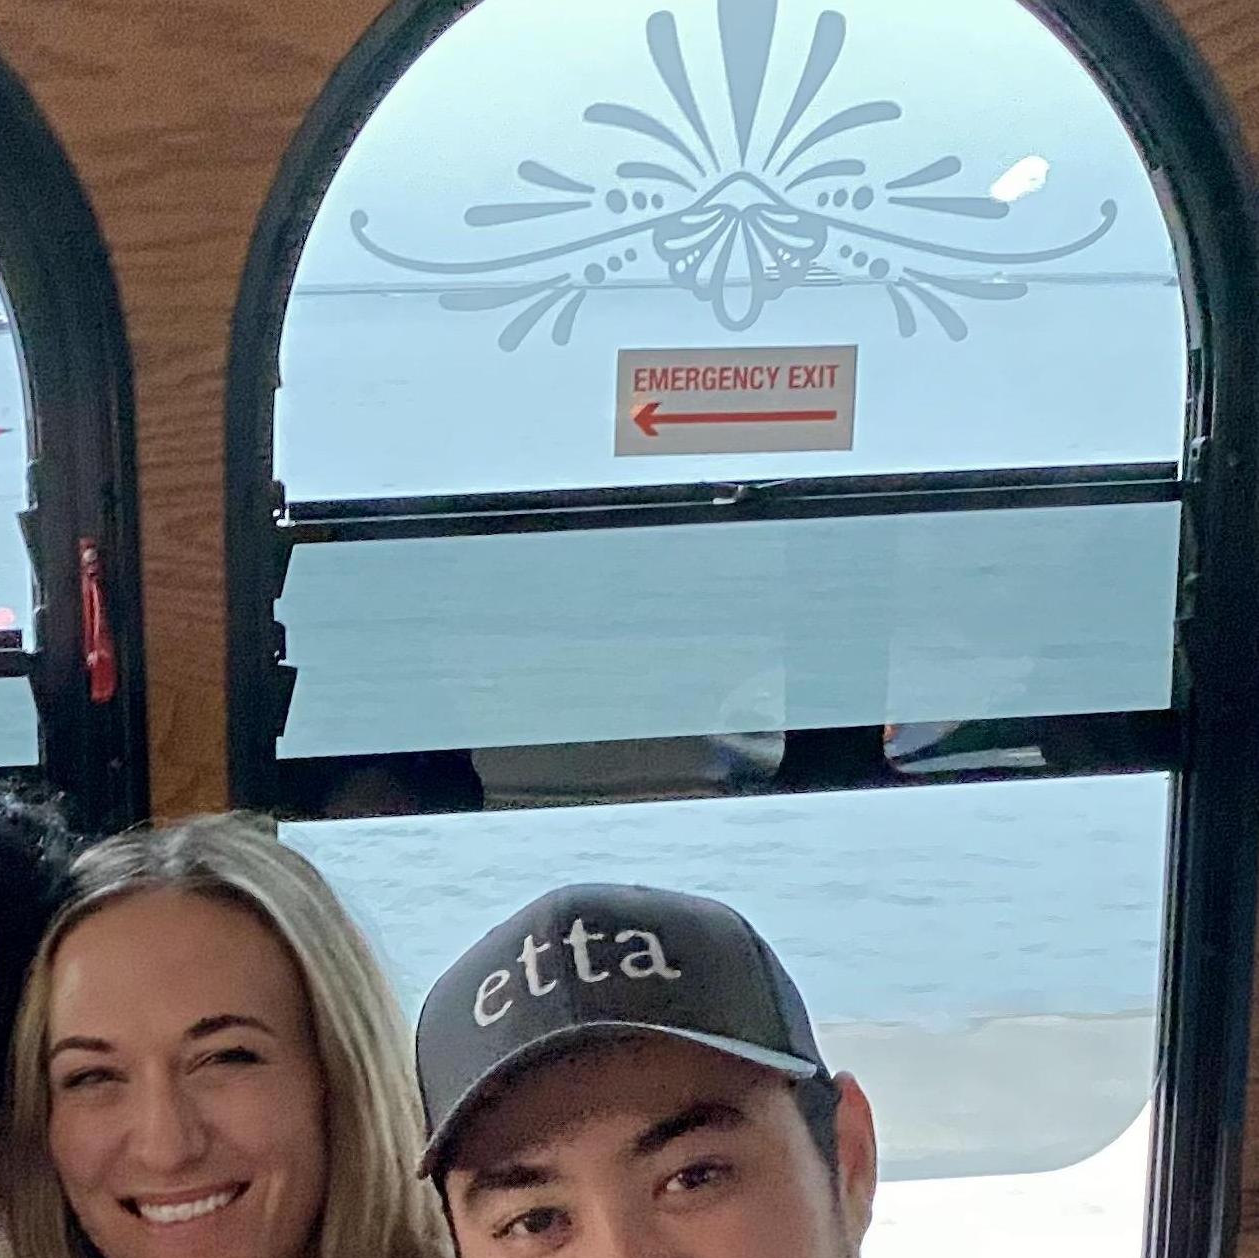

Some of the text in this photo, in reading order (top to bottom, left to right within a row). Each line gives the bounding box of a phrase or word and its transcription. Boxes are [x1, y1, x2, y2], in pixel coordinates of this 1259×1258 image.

[633, 365, 839, 392] EMERGENCY EXIT
[474, 918, 681, 1026] etta
